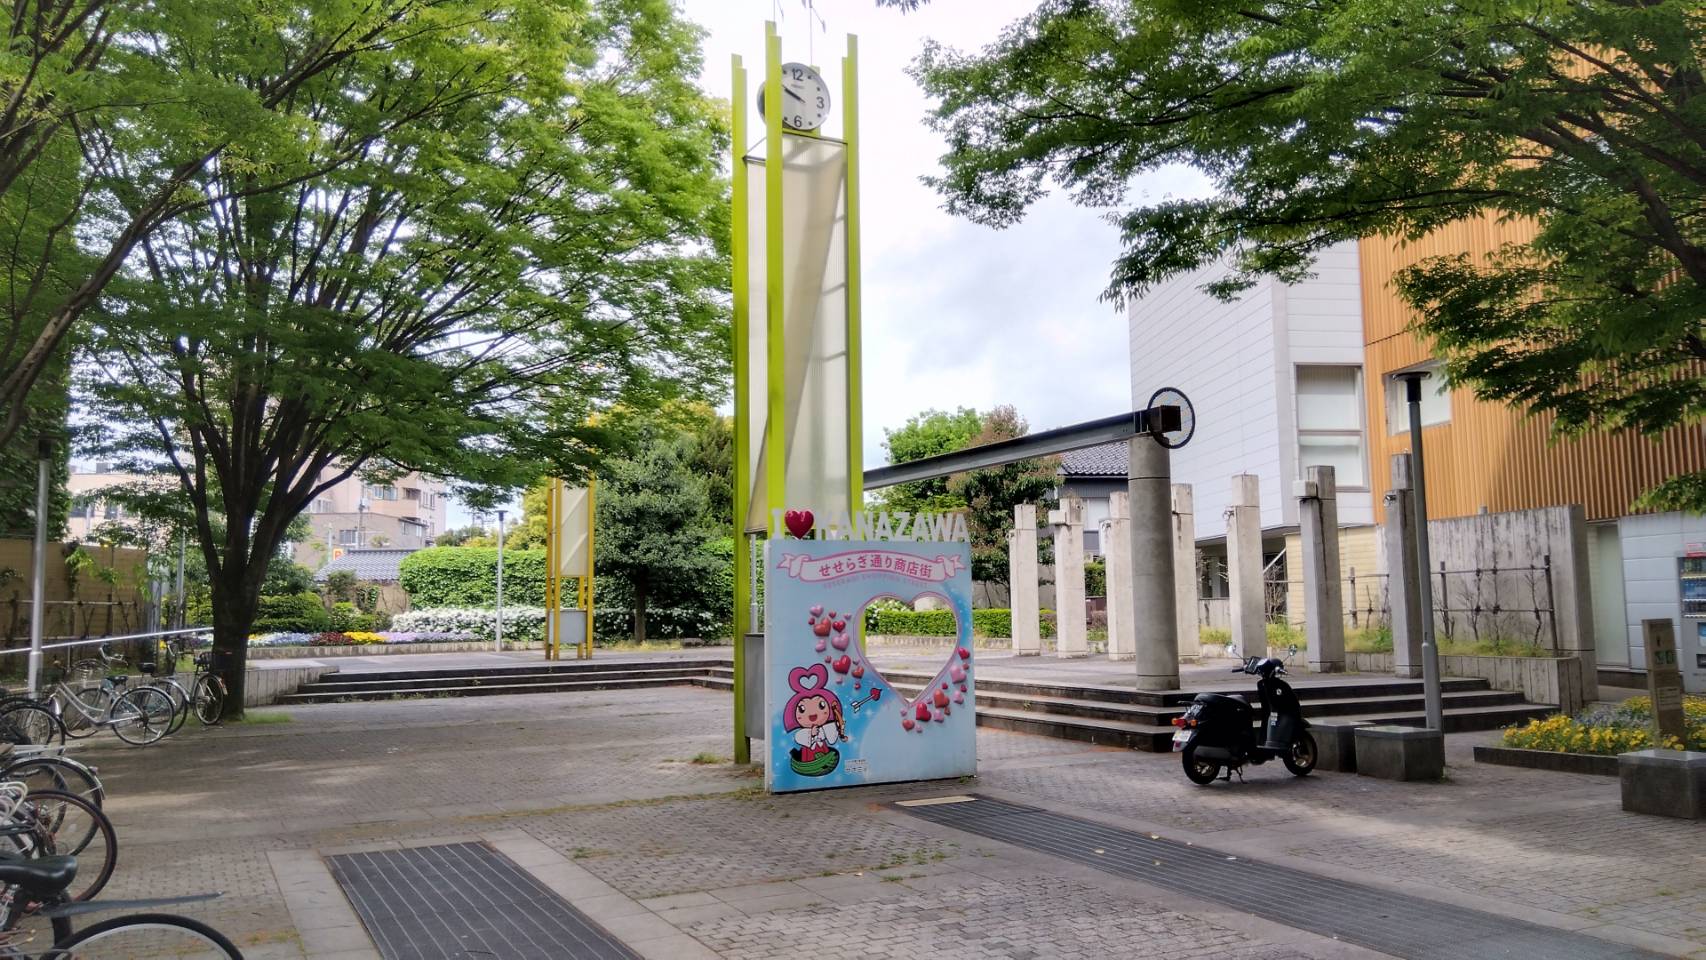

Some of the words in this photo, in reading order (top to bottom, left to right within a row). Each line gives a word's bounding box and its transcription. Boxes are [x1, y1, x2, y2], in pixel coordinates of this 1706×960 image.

[792, 68, 804, 81] 12
[816, 96, 825, 109] 3
[794, 115, 802, 128] 6
[815, 511, 970, 542] KANAZAWA
[819, 554, 932, 578] せせらぎ通り商店街
